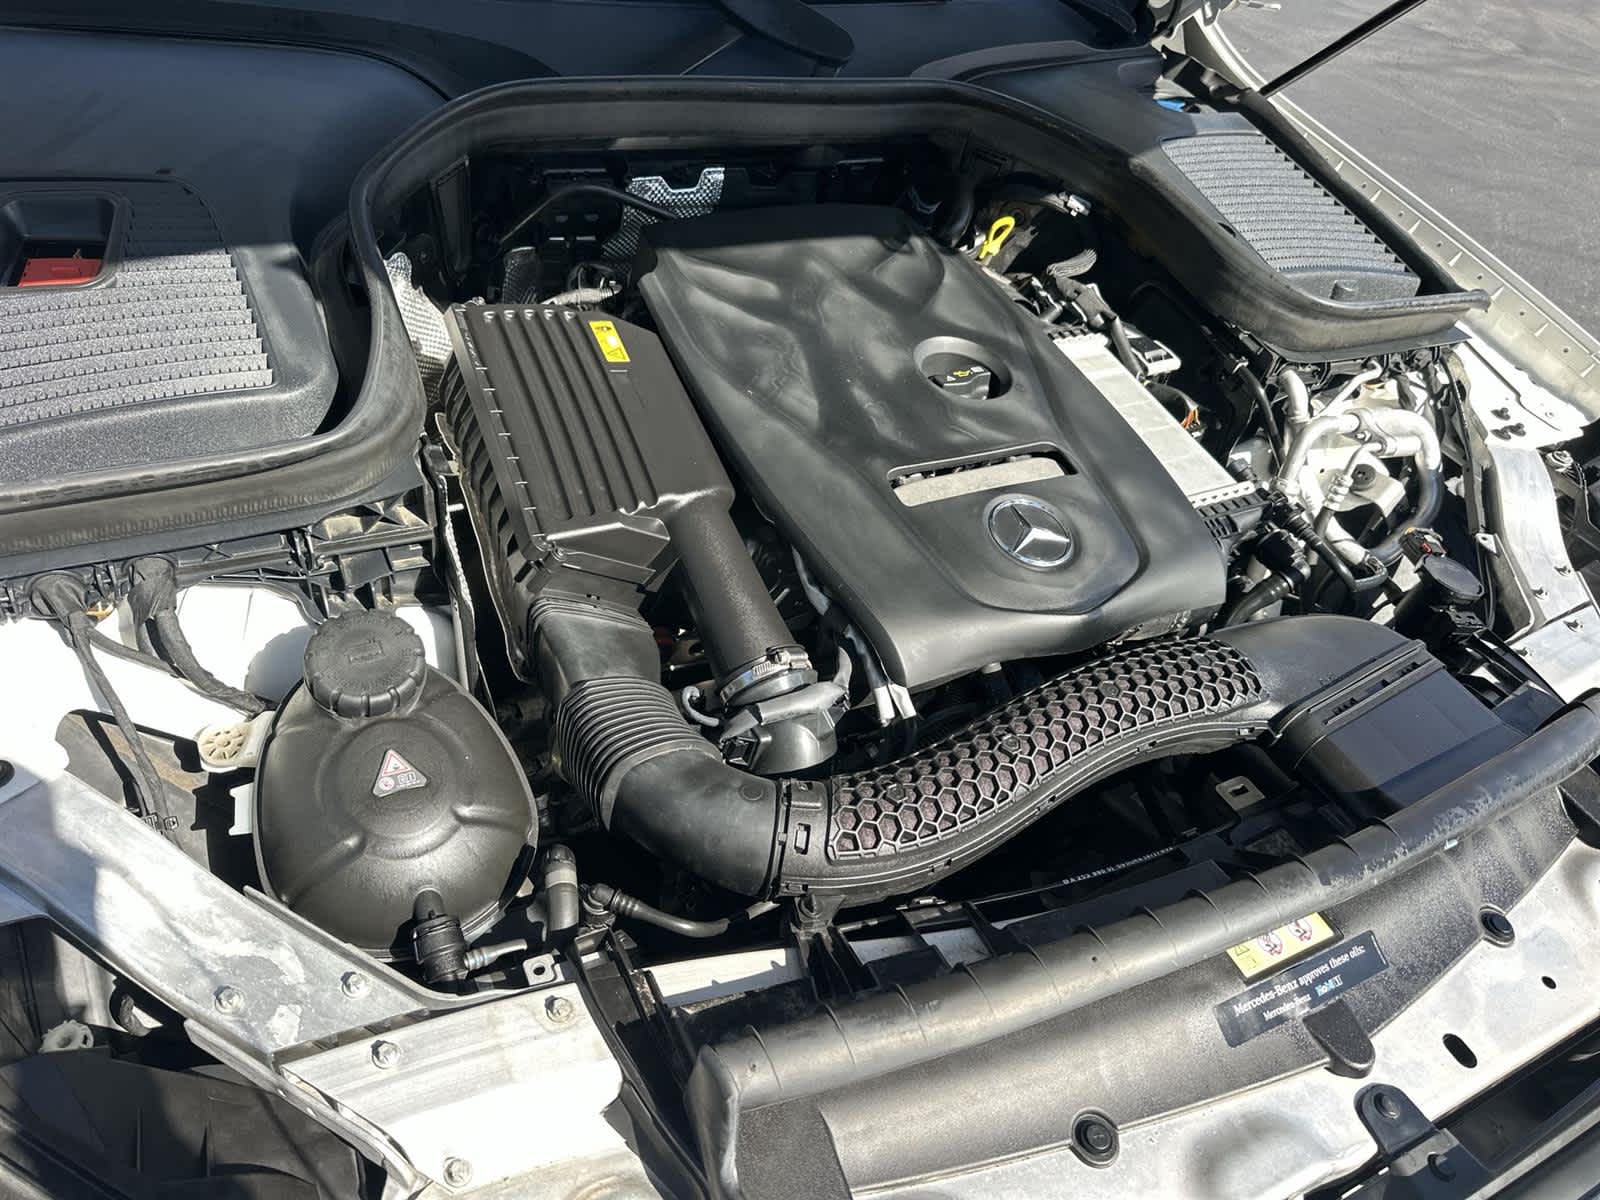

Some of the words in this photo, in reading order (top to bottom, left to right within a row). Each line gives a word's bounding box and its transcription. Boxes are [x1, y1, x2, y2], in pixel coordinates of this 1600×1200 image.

[1233, 979, 1299, 1017] Mercedes-Benz
[1298, 963, 1330, 986] approves
[1328, 952, 1350, 969] these
